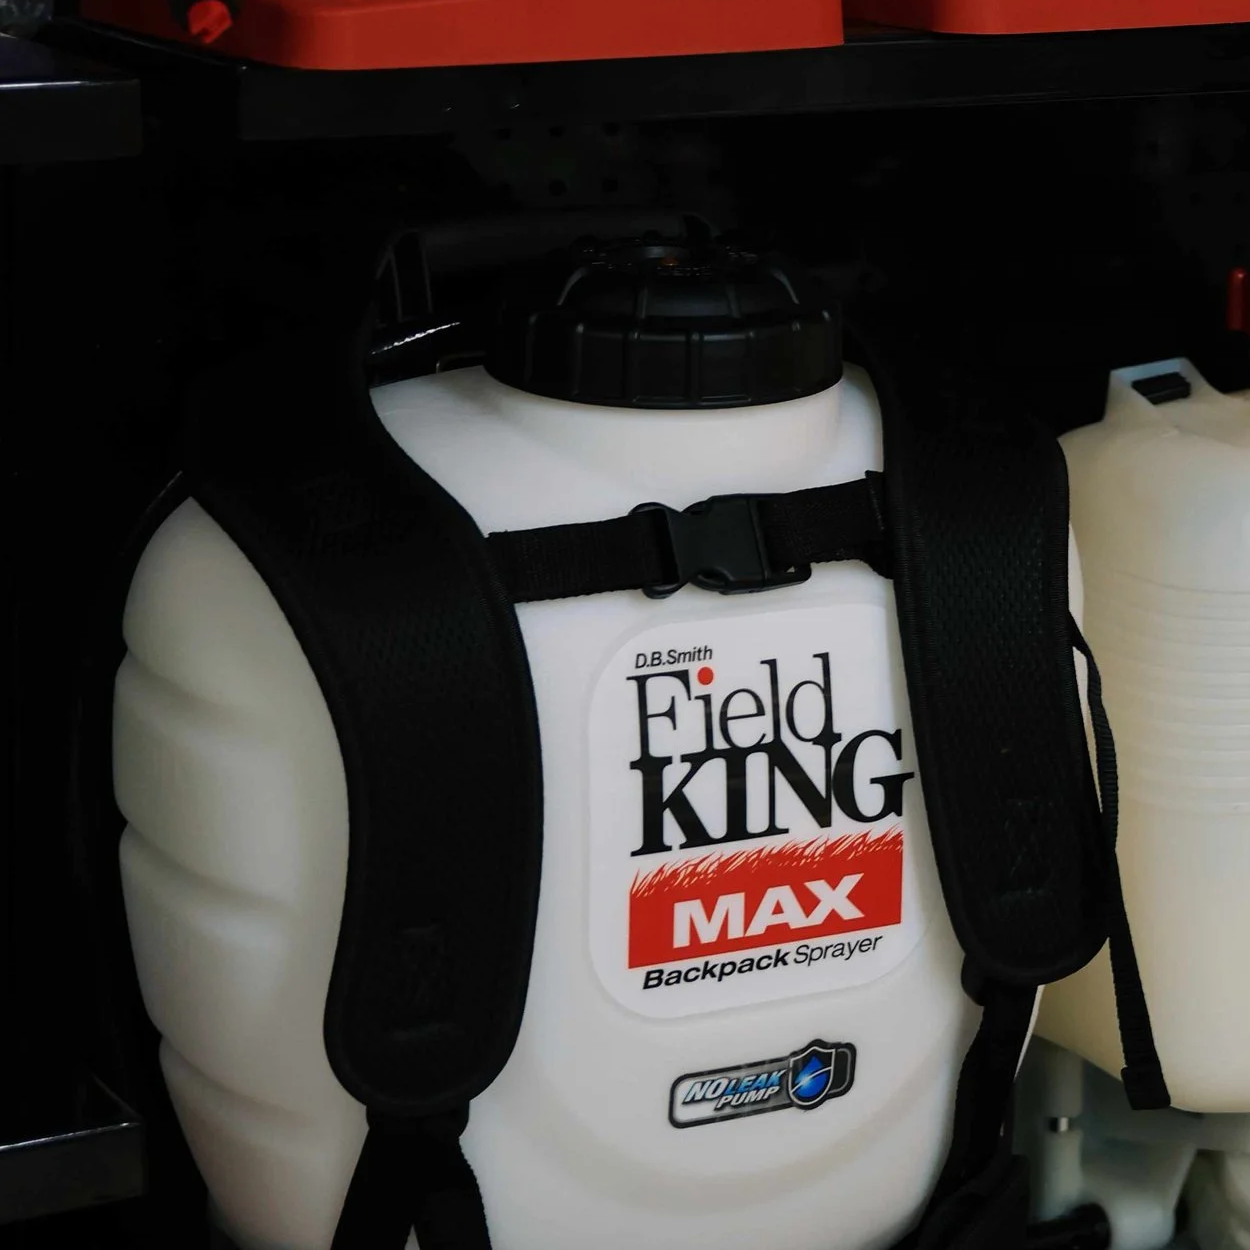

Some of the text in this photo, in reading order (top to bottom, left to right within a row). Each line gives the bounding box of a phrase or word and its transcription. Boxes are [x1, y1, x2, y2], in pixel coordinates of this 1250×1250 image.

[635, 645, 713, 669] D.B.Smith
[626, 652, 842, 760] Field
[629, 729, 915, 857] KING
[672, 872, 865, 949] MAX
[642, 934, 883, 990] Backpack Sprayer
[714, 1086, 780, 1111] PUMP
